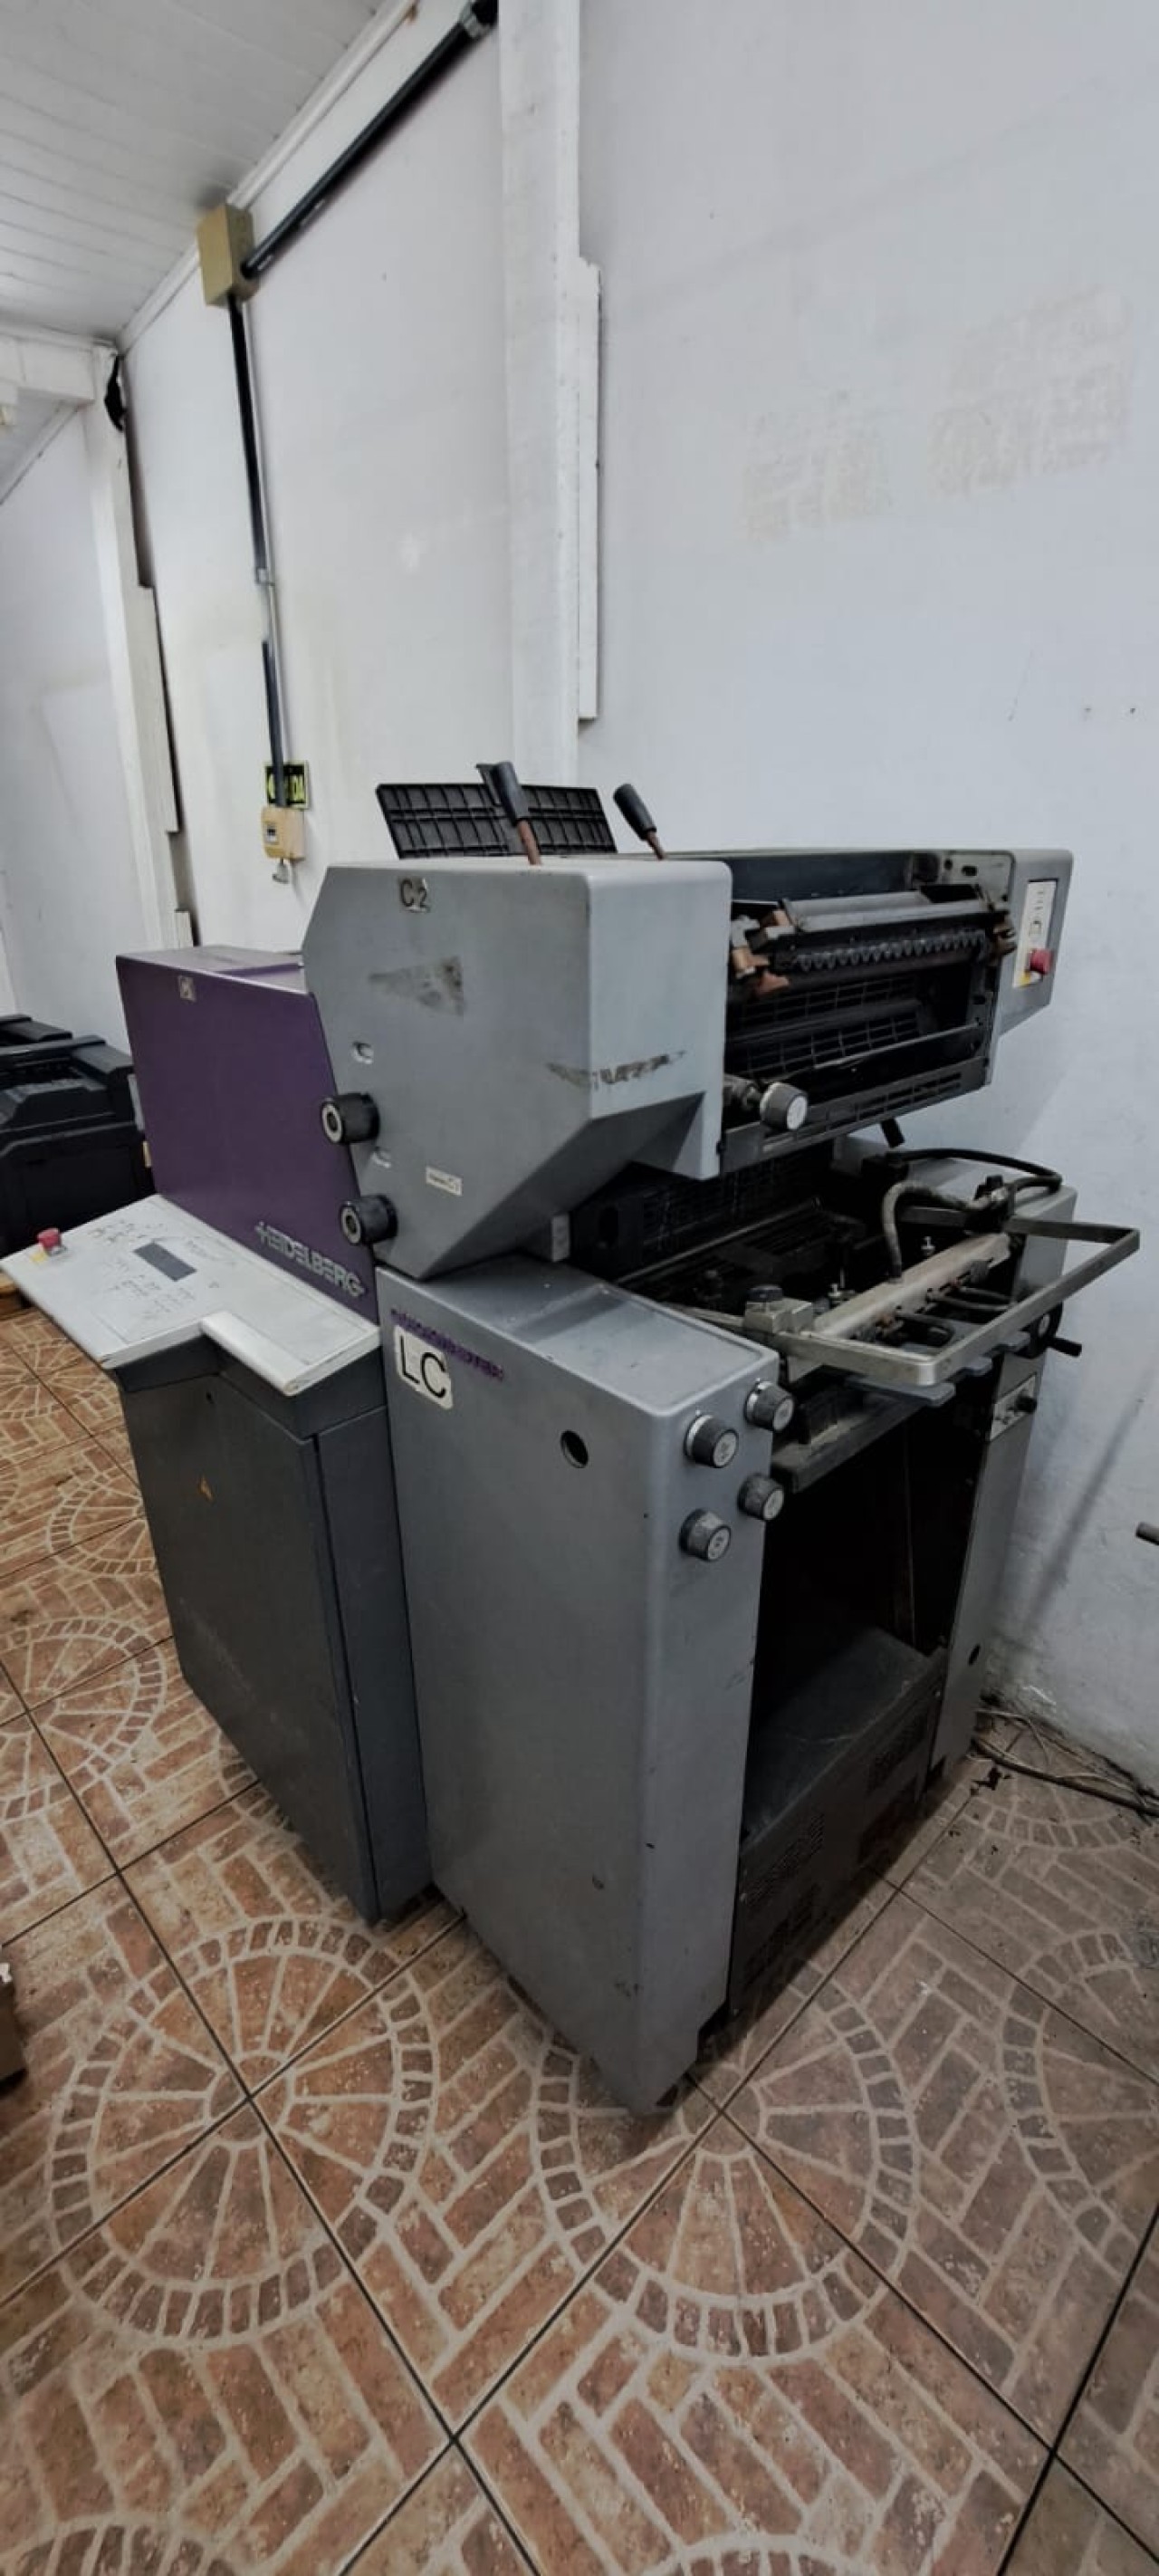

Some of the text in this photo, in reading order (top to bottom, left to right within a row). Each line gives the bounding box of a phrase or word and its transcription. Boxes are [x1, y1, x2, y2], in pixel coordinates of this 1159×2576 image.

[399, 878, 427, 907] C2
[254, 1221, 365, 1296] HEIDELBERG
[400, 1334, 446, 1399] LC
